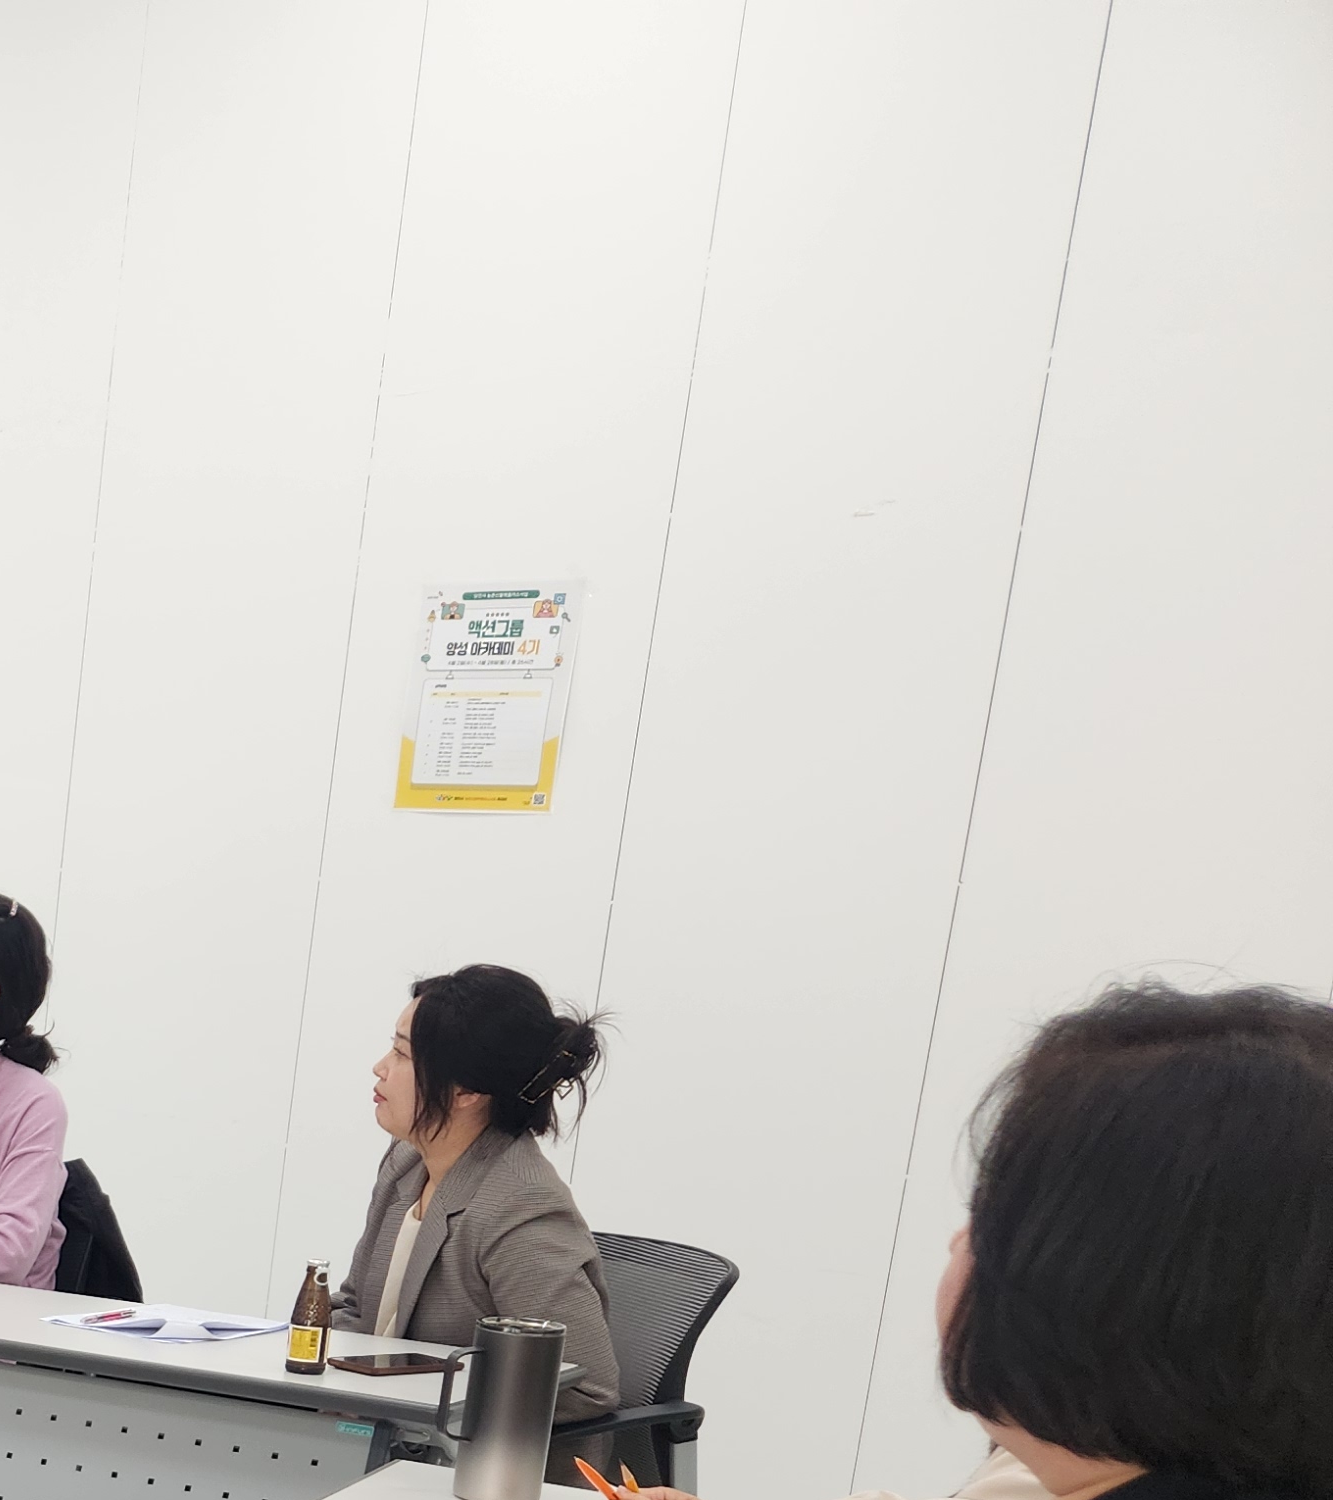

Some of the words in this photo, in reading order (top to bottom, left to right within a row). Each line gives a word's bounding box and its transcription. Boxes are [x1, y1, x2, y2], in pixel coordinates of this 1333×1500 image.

[467, 619, 524, 638] 액션그룹
[446, 641, 469, 656] 양성
[470, 640, 515, 656] 아카데미
[517, 639, 540, 655] 4기
